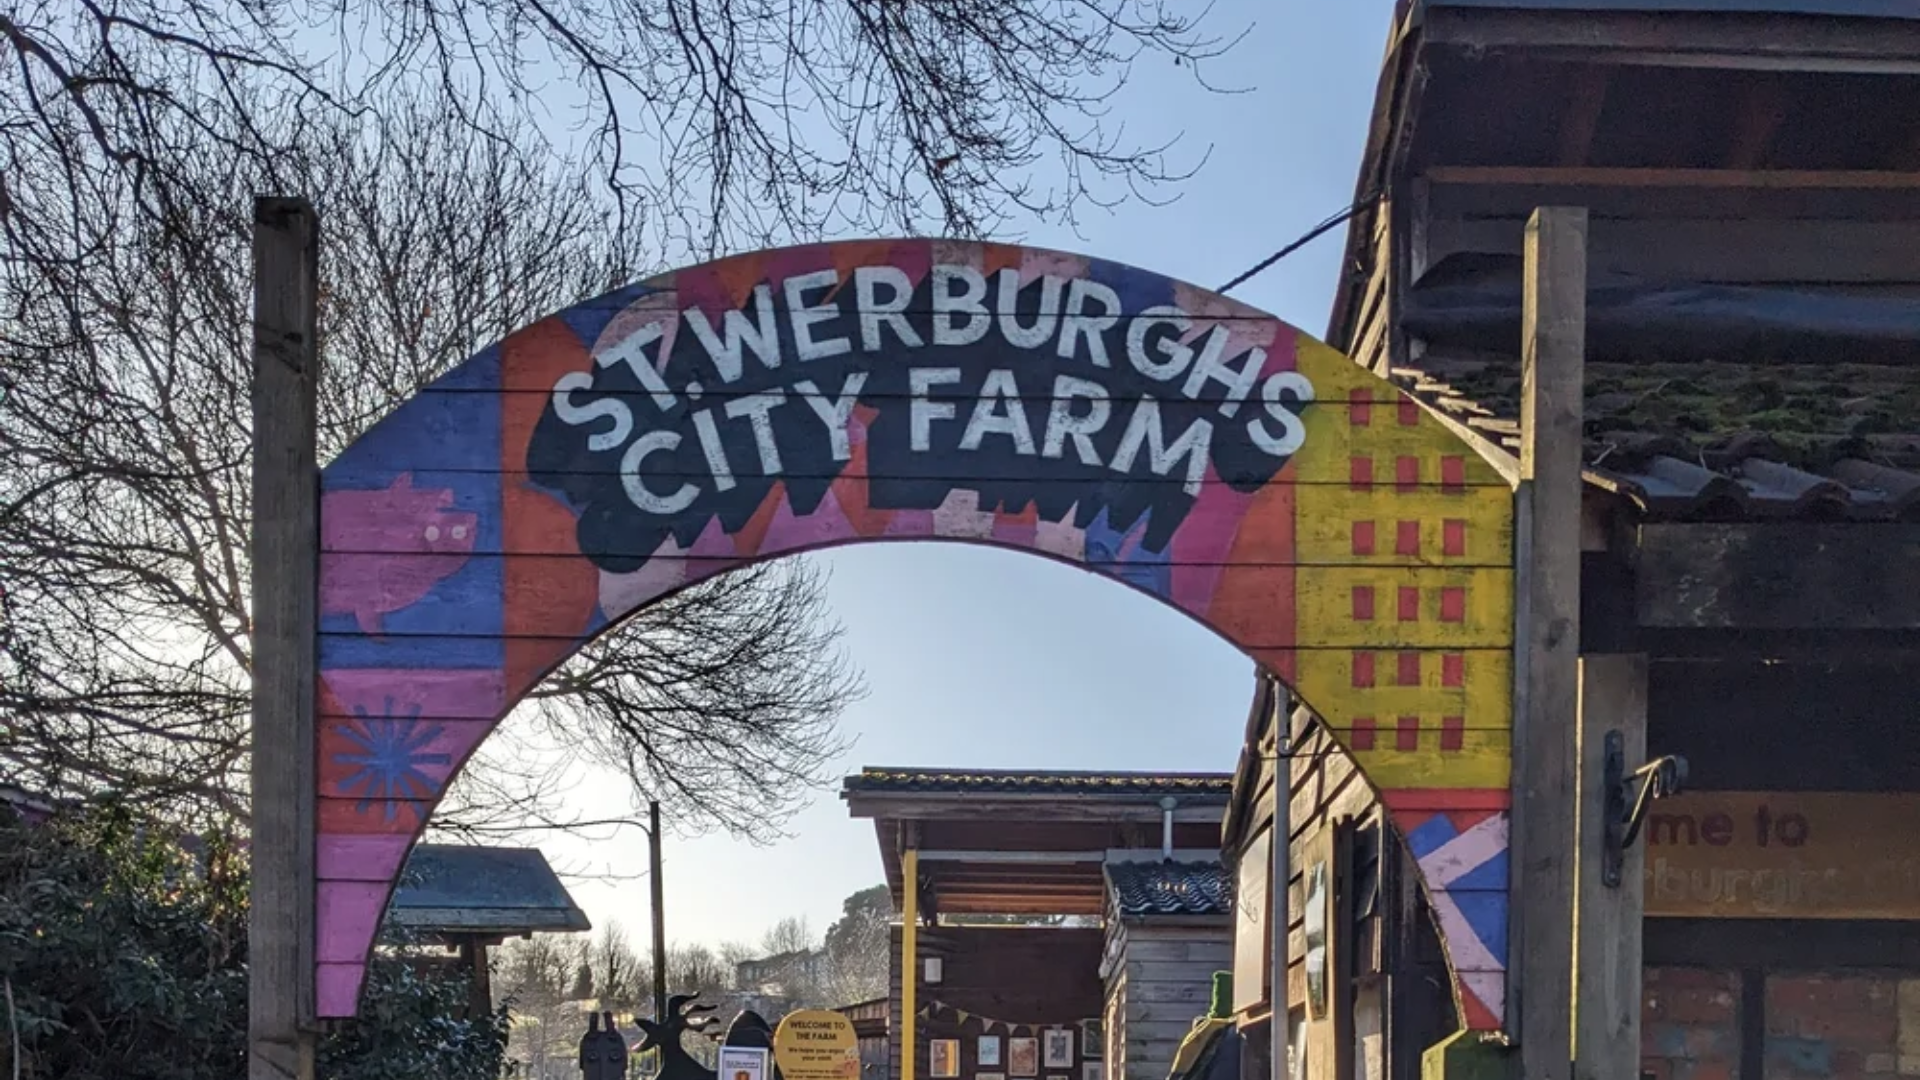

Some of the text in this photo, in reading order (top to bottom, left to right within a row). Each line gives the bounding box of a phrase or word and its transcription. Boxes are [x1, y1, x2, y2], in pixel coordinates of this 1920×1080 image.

[682, 263, 1315, 457] WERBURGHS
[908, 366, 1214, 498] FARM
[1754, 804, 1809, 847] to
[790, 1021, 846, 1030] WELCOME TO
[796, 1031, 837, 1040] THE FARM
